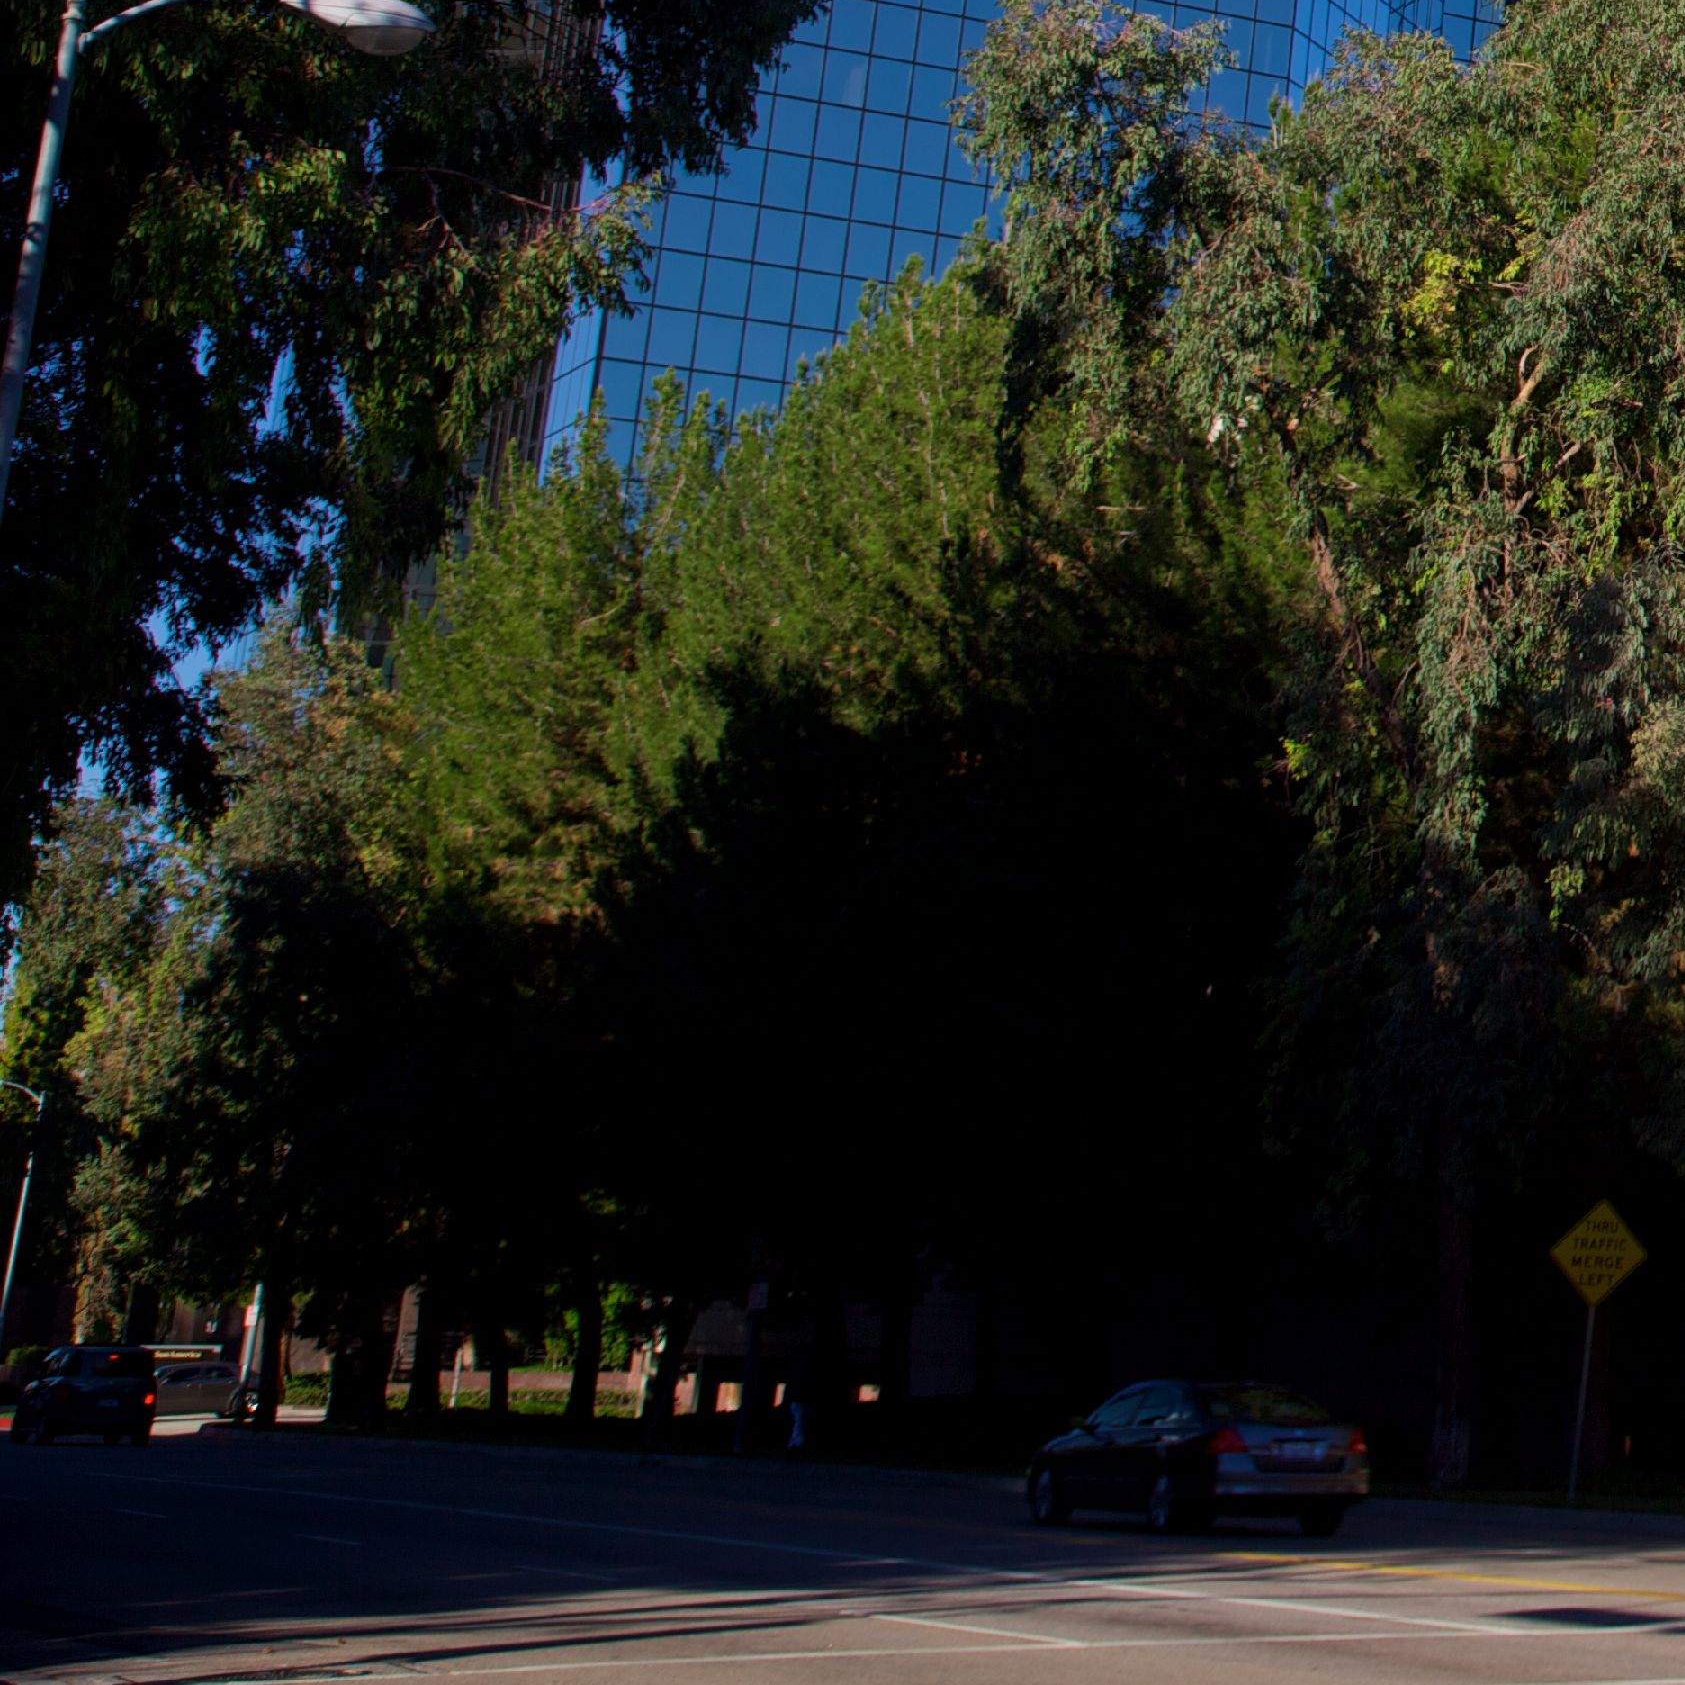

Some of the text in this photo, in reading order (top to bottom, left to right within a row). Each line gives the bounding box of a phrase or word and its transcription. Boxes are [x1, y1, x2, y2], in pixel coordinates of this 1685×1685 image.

[1585, 1220, 1619, 1234] THRU
[1573, 1238, 1627, 1252] TRAFFIC
[1571, 1256, 1625, 1270] MERGE
[1579, 1274, 1615, 1286] LEFT
